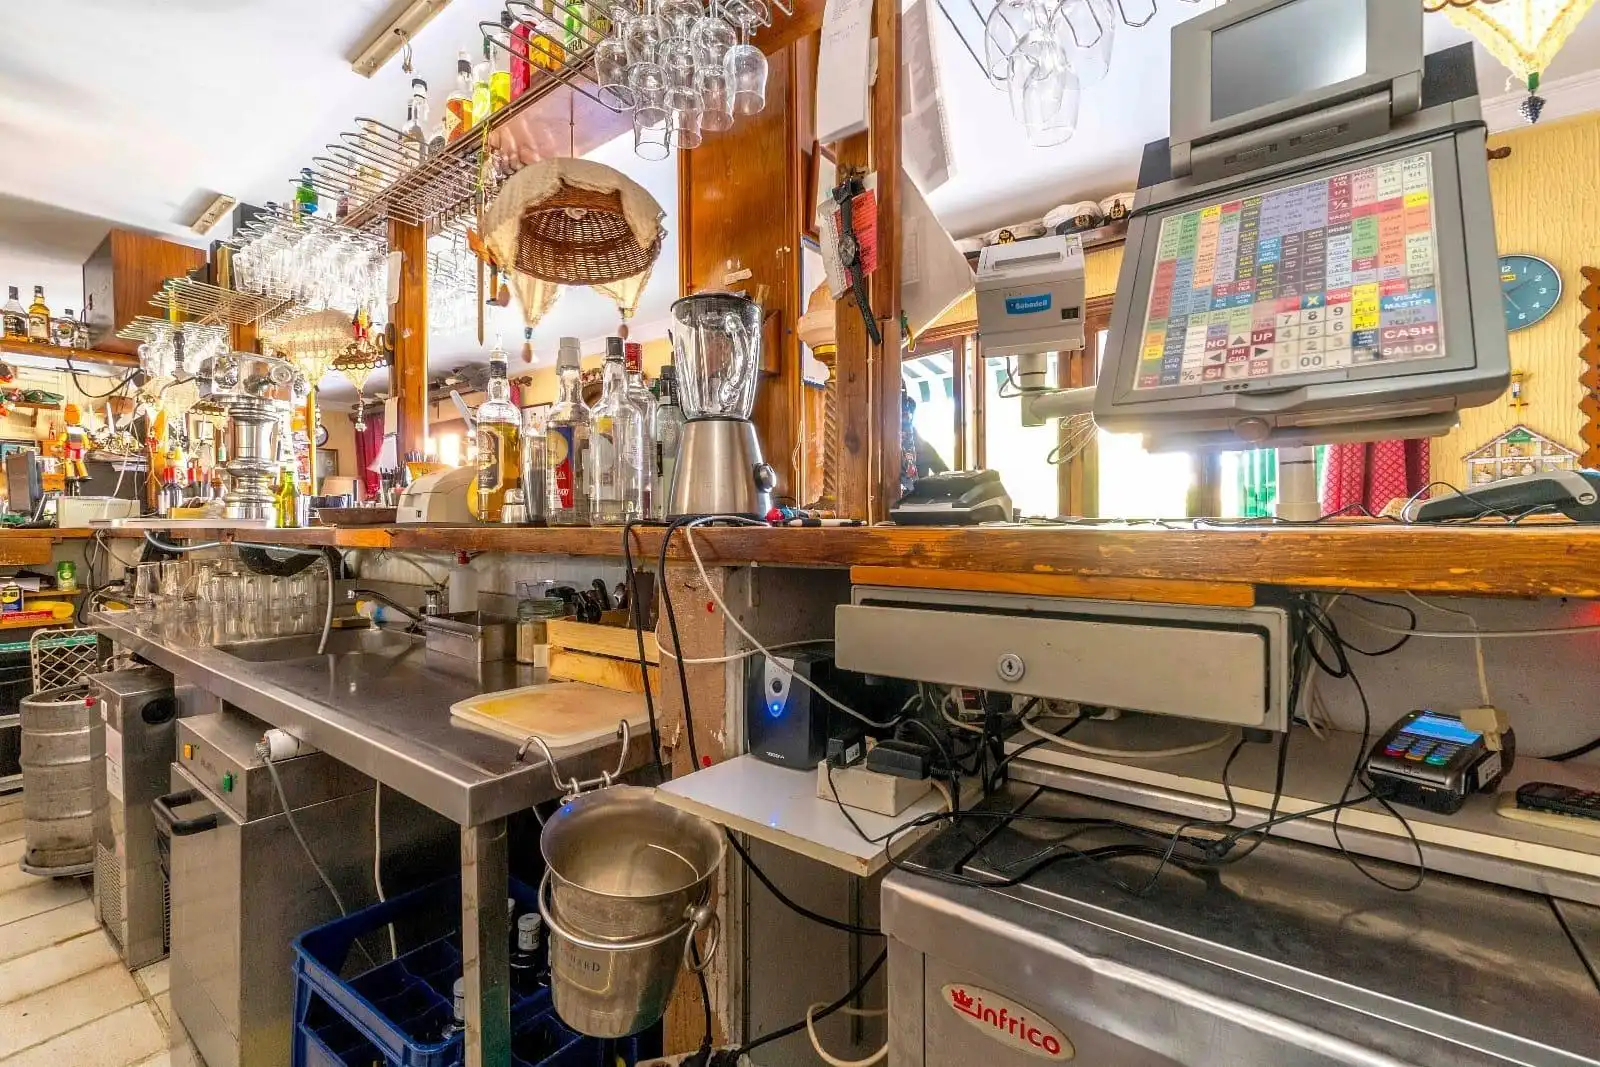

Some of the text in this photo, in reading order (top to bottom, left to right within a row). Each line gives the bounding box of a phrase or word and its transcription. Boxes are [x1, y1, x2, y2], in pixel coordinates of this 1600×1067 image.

[1501, 265, 1511, 273] 12
[1534, 274, 1542, 282] 2
[1532, 301, 1540, 309] 4
[1333, 306, 1343, 316] 9
[1284, 314, 1292, 325] 7
[1308, 311, 1318, 321] 8
[1518, 312, 1526, 320] 5
[1308, 326, 1318, 335] 5
[1333, 322, 1344, 331] 6
[1383, 325, 1434, 339] CASH
[1253, 332, 1273, 342] UP
[1206, 339, 1226, 348] NO
[1306, 341, 1317, 350] 2
[1383, 343, 1437, 356] SALDO
[1205, 367, 1222, 378] SI
[976, 997, 1061, 1055] infrico
